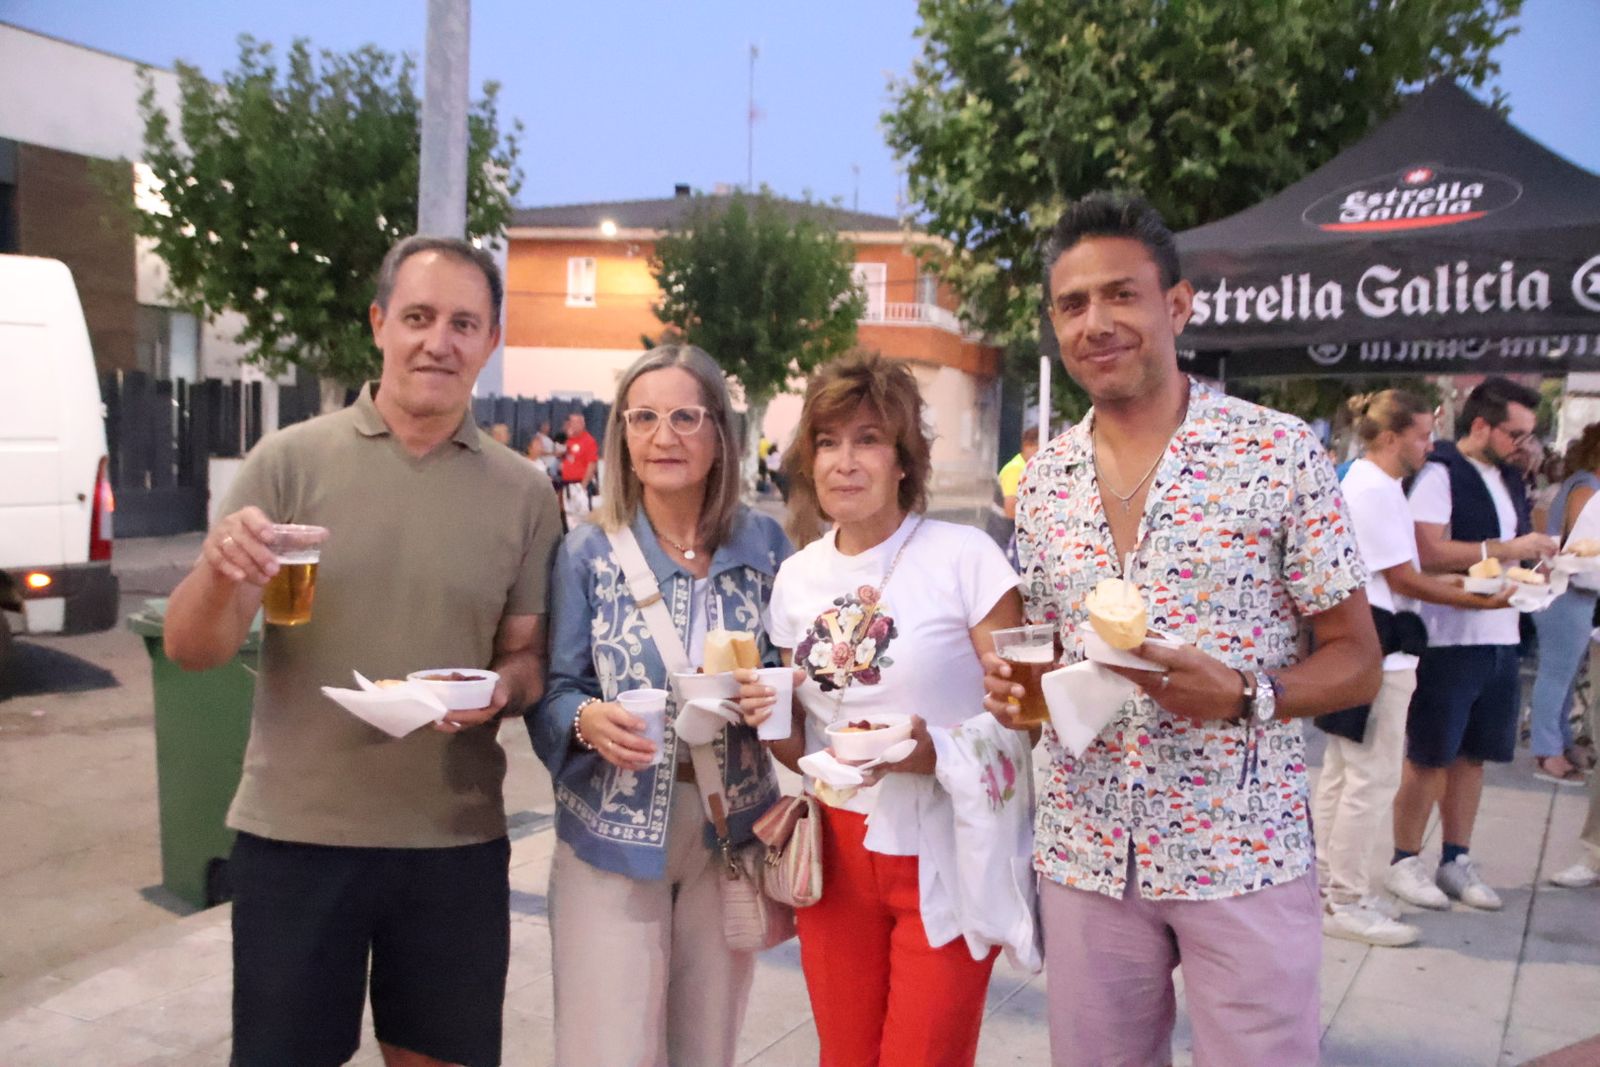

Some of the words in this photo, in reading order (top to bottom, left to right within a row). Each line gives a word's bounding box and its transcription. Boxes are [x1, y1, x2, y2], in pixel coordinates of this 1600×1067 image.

[1341, 181, 1484, 209] Estrella
[1338, 199, 1473, 224] Galicia
[1189, 272, 1345, 326] strella
[1356, 260, 1553, 319] Galicia
